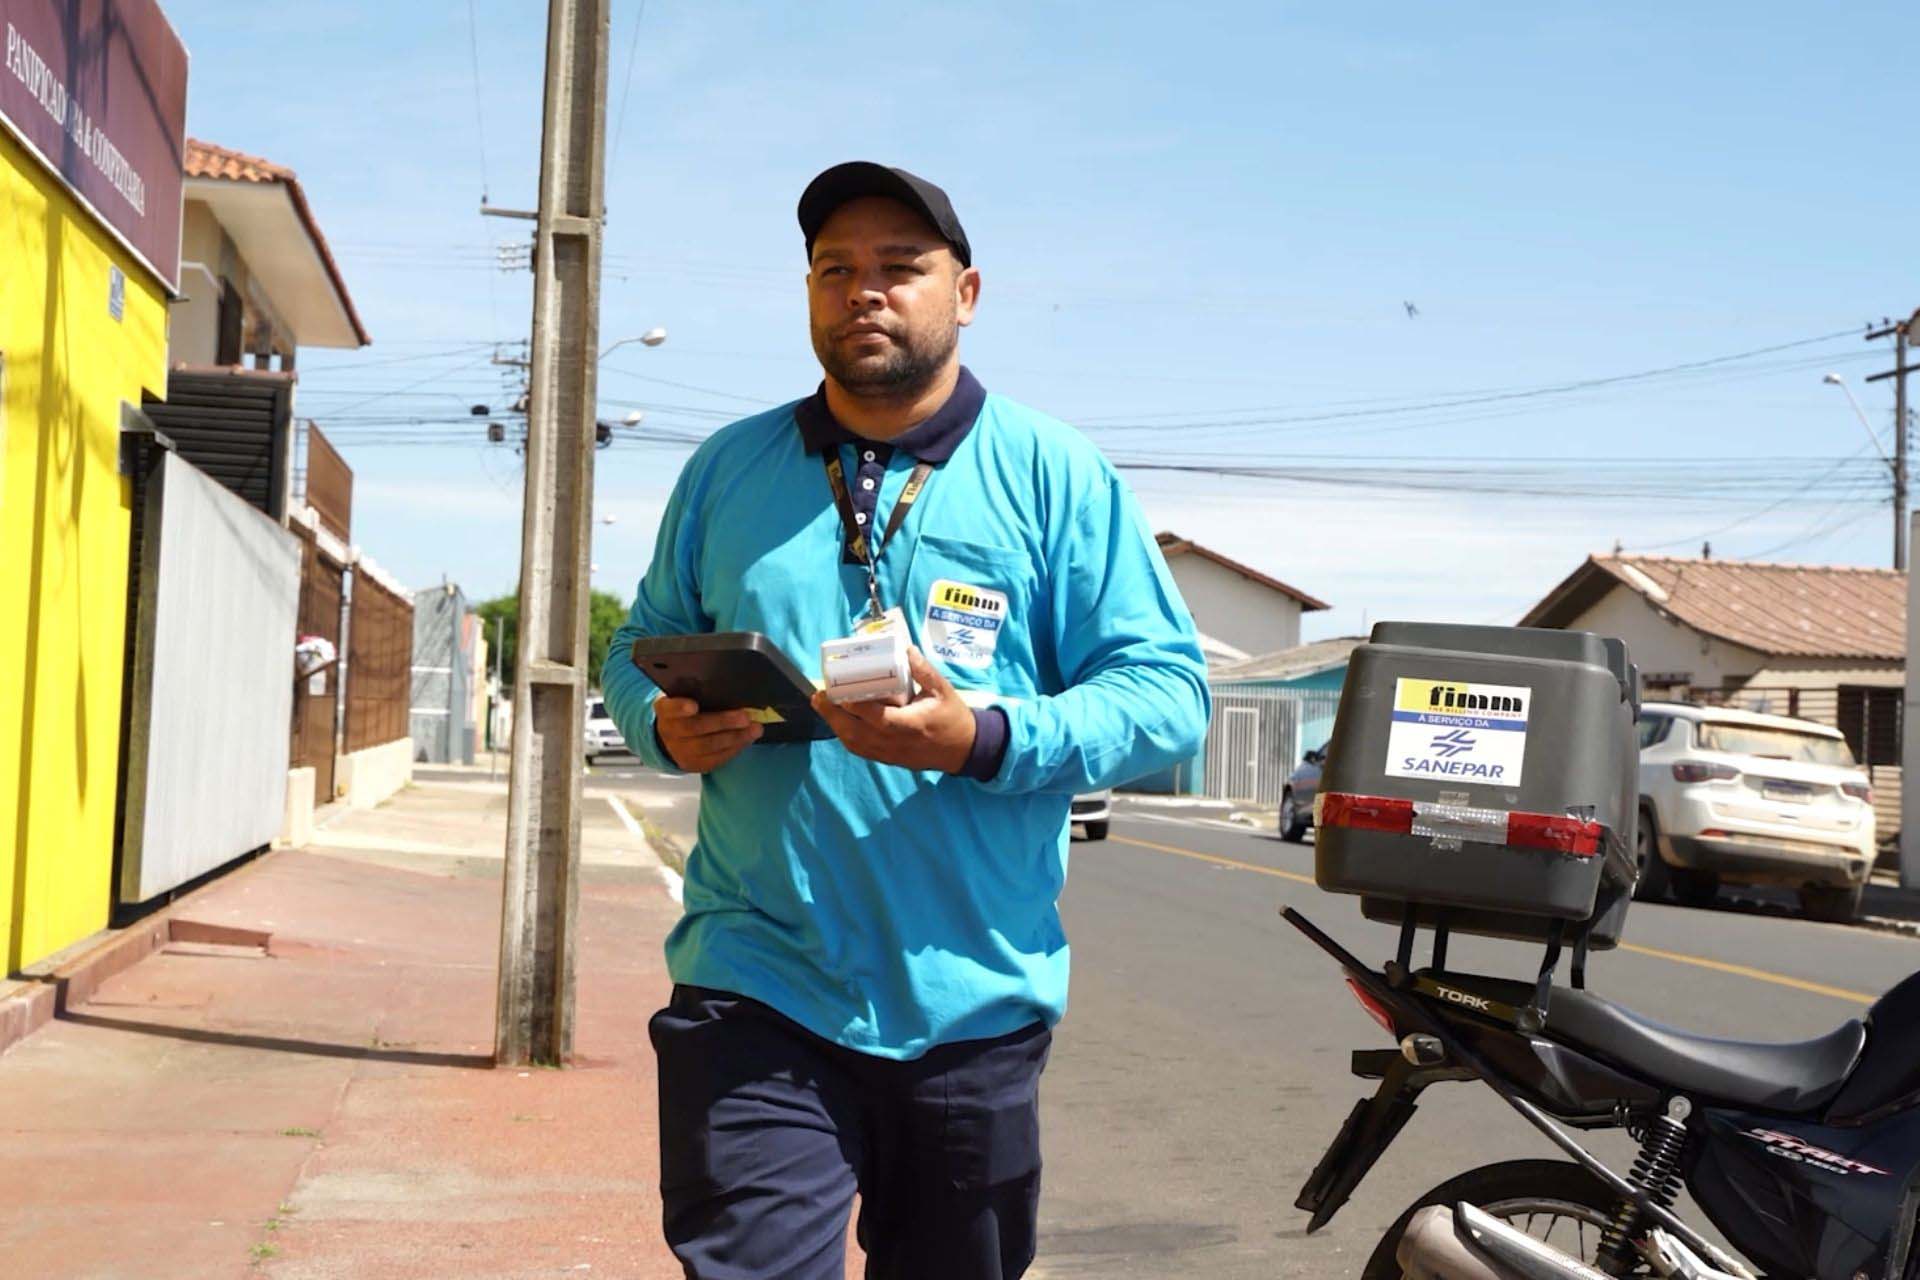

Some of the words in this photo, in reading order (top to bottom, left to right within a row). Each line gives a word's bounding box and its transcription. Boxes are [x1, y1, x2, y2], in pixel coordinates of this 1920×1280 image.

[84, 116, 91, 157] &
[1430, 686, 1523, 712] fimm
[1418, 714, 1426, 722] A
[1428, 715, 1474, 727] SERVIÇO
[1475, 718, 1490, 728] DA
[1402, 757, 1504, 778] SANEPAR
[1437, 986, 1490, 1012] TORK
